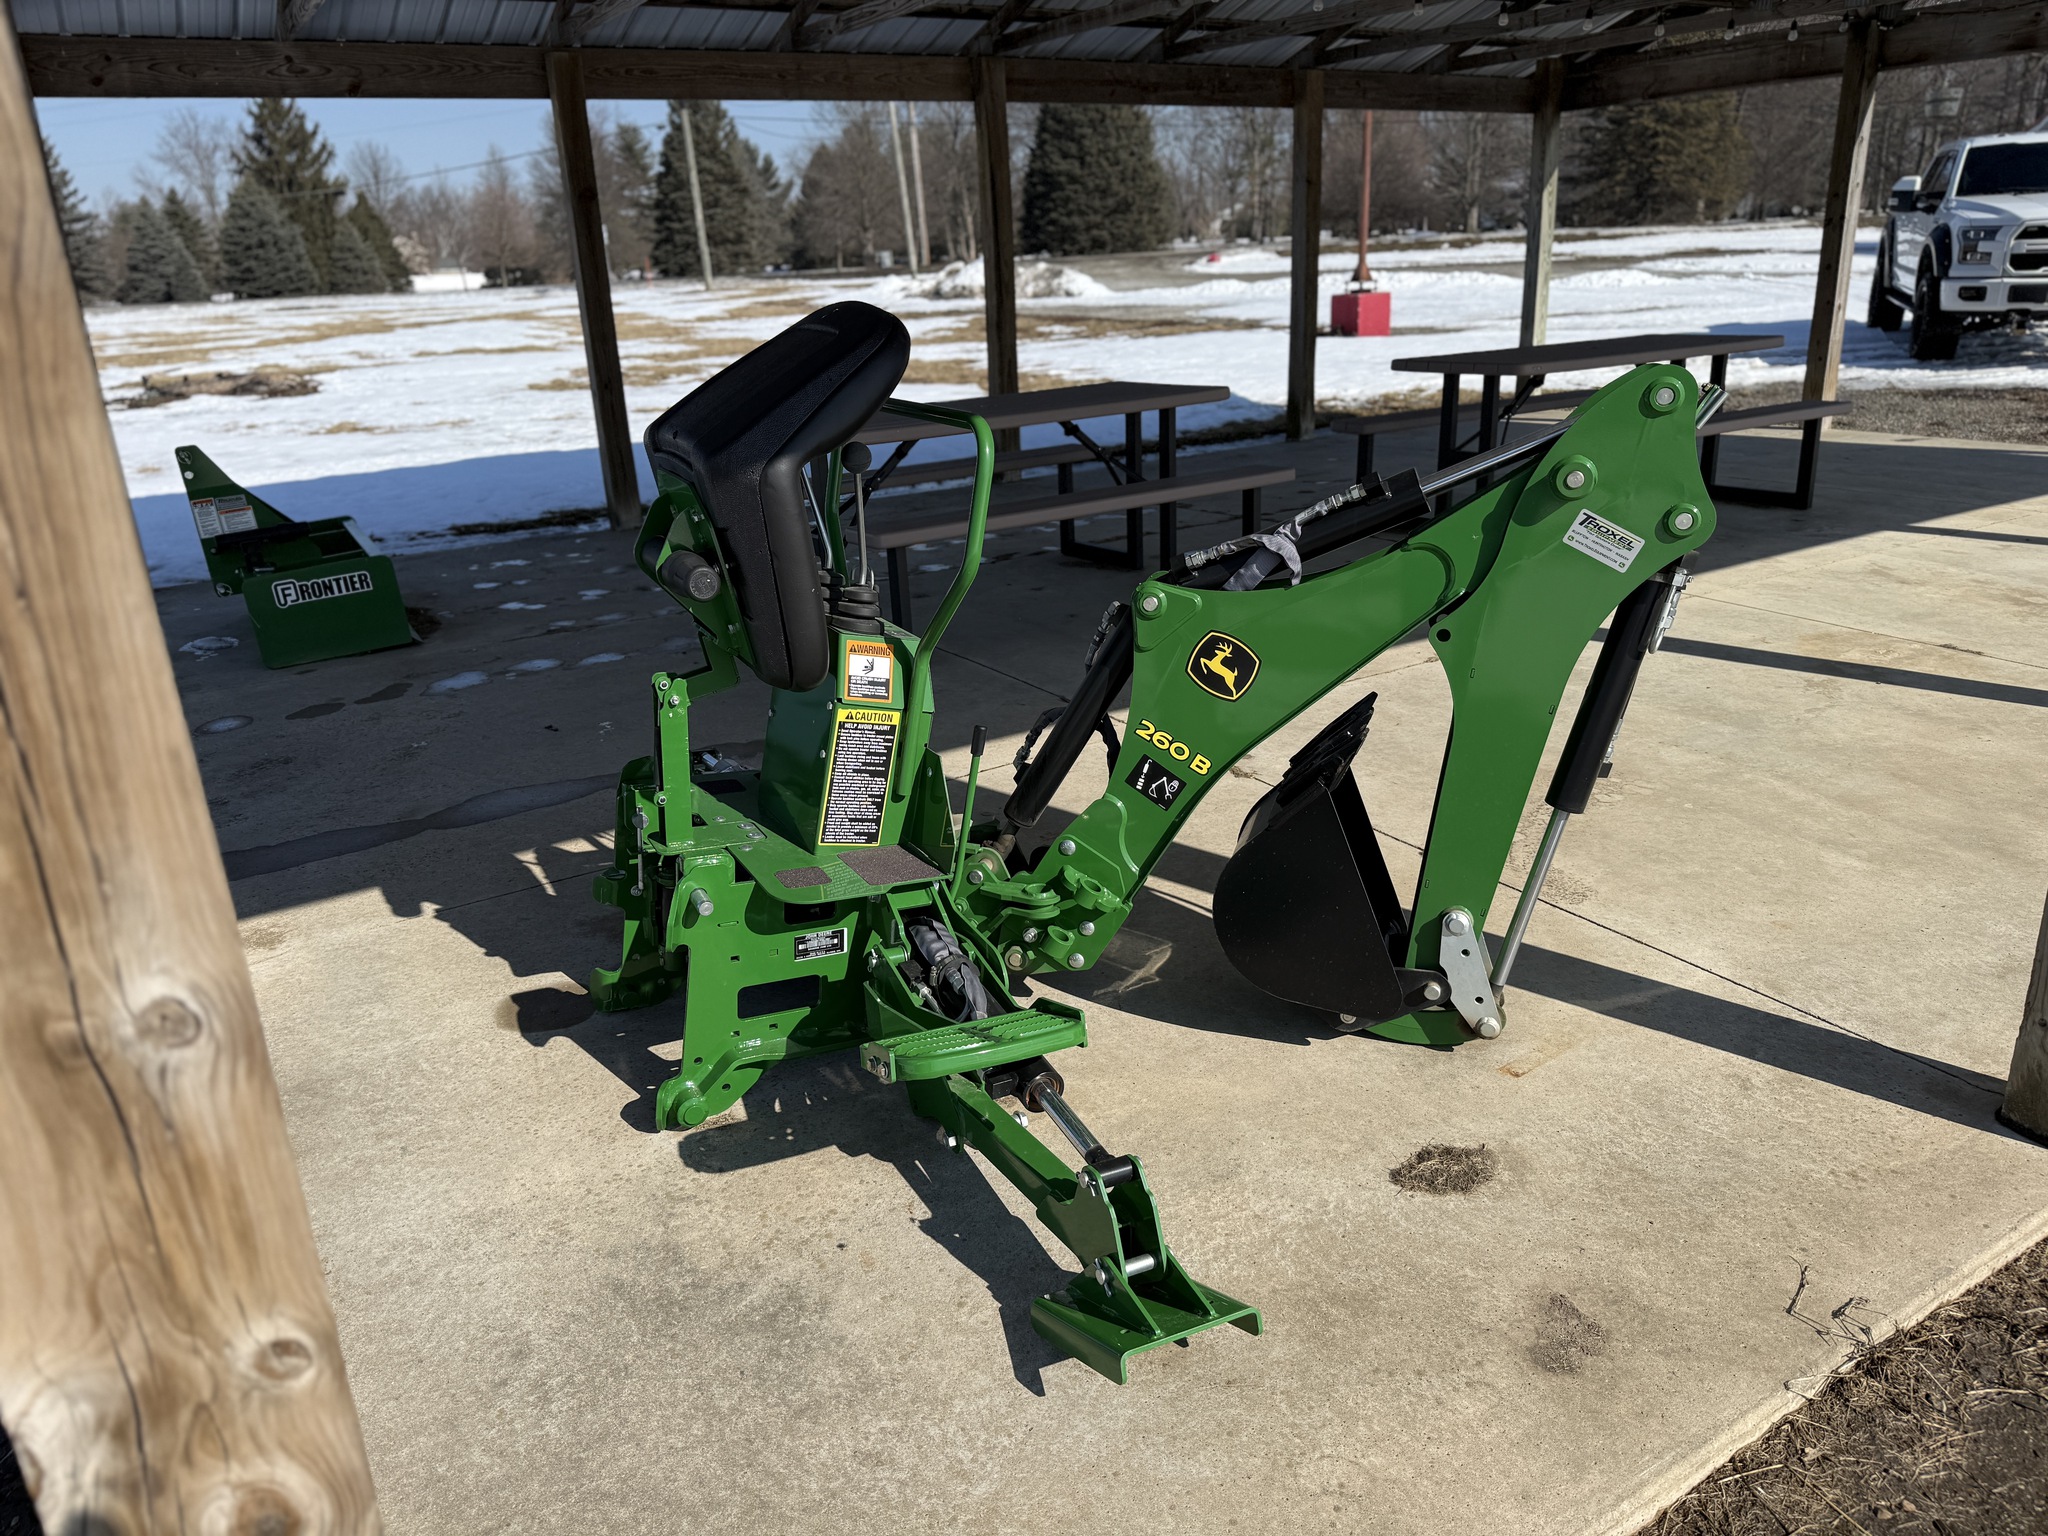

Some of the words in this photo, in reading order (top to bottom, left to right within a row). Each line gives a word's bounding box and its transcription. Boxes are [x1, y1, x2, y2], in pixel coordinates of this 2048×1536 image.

[1578, 512, 1635, 549] TROXEL
[272, 572, 372, 607] FRONTIER
[857, 643, 891, 656] WARNING
[855, 711, 893, 722] CAUTION
[1135, 719, 1190, 761] 260
[1189, 753, 1212, 775] B
